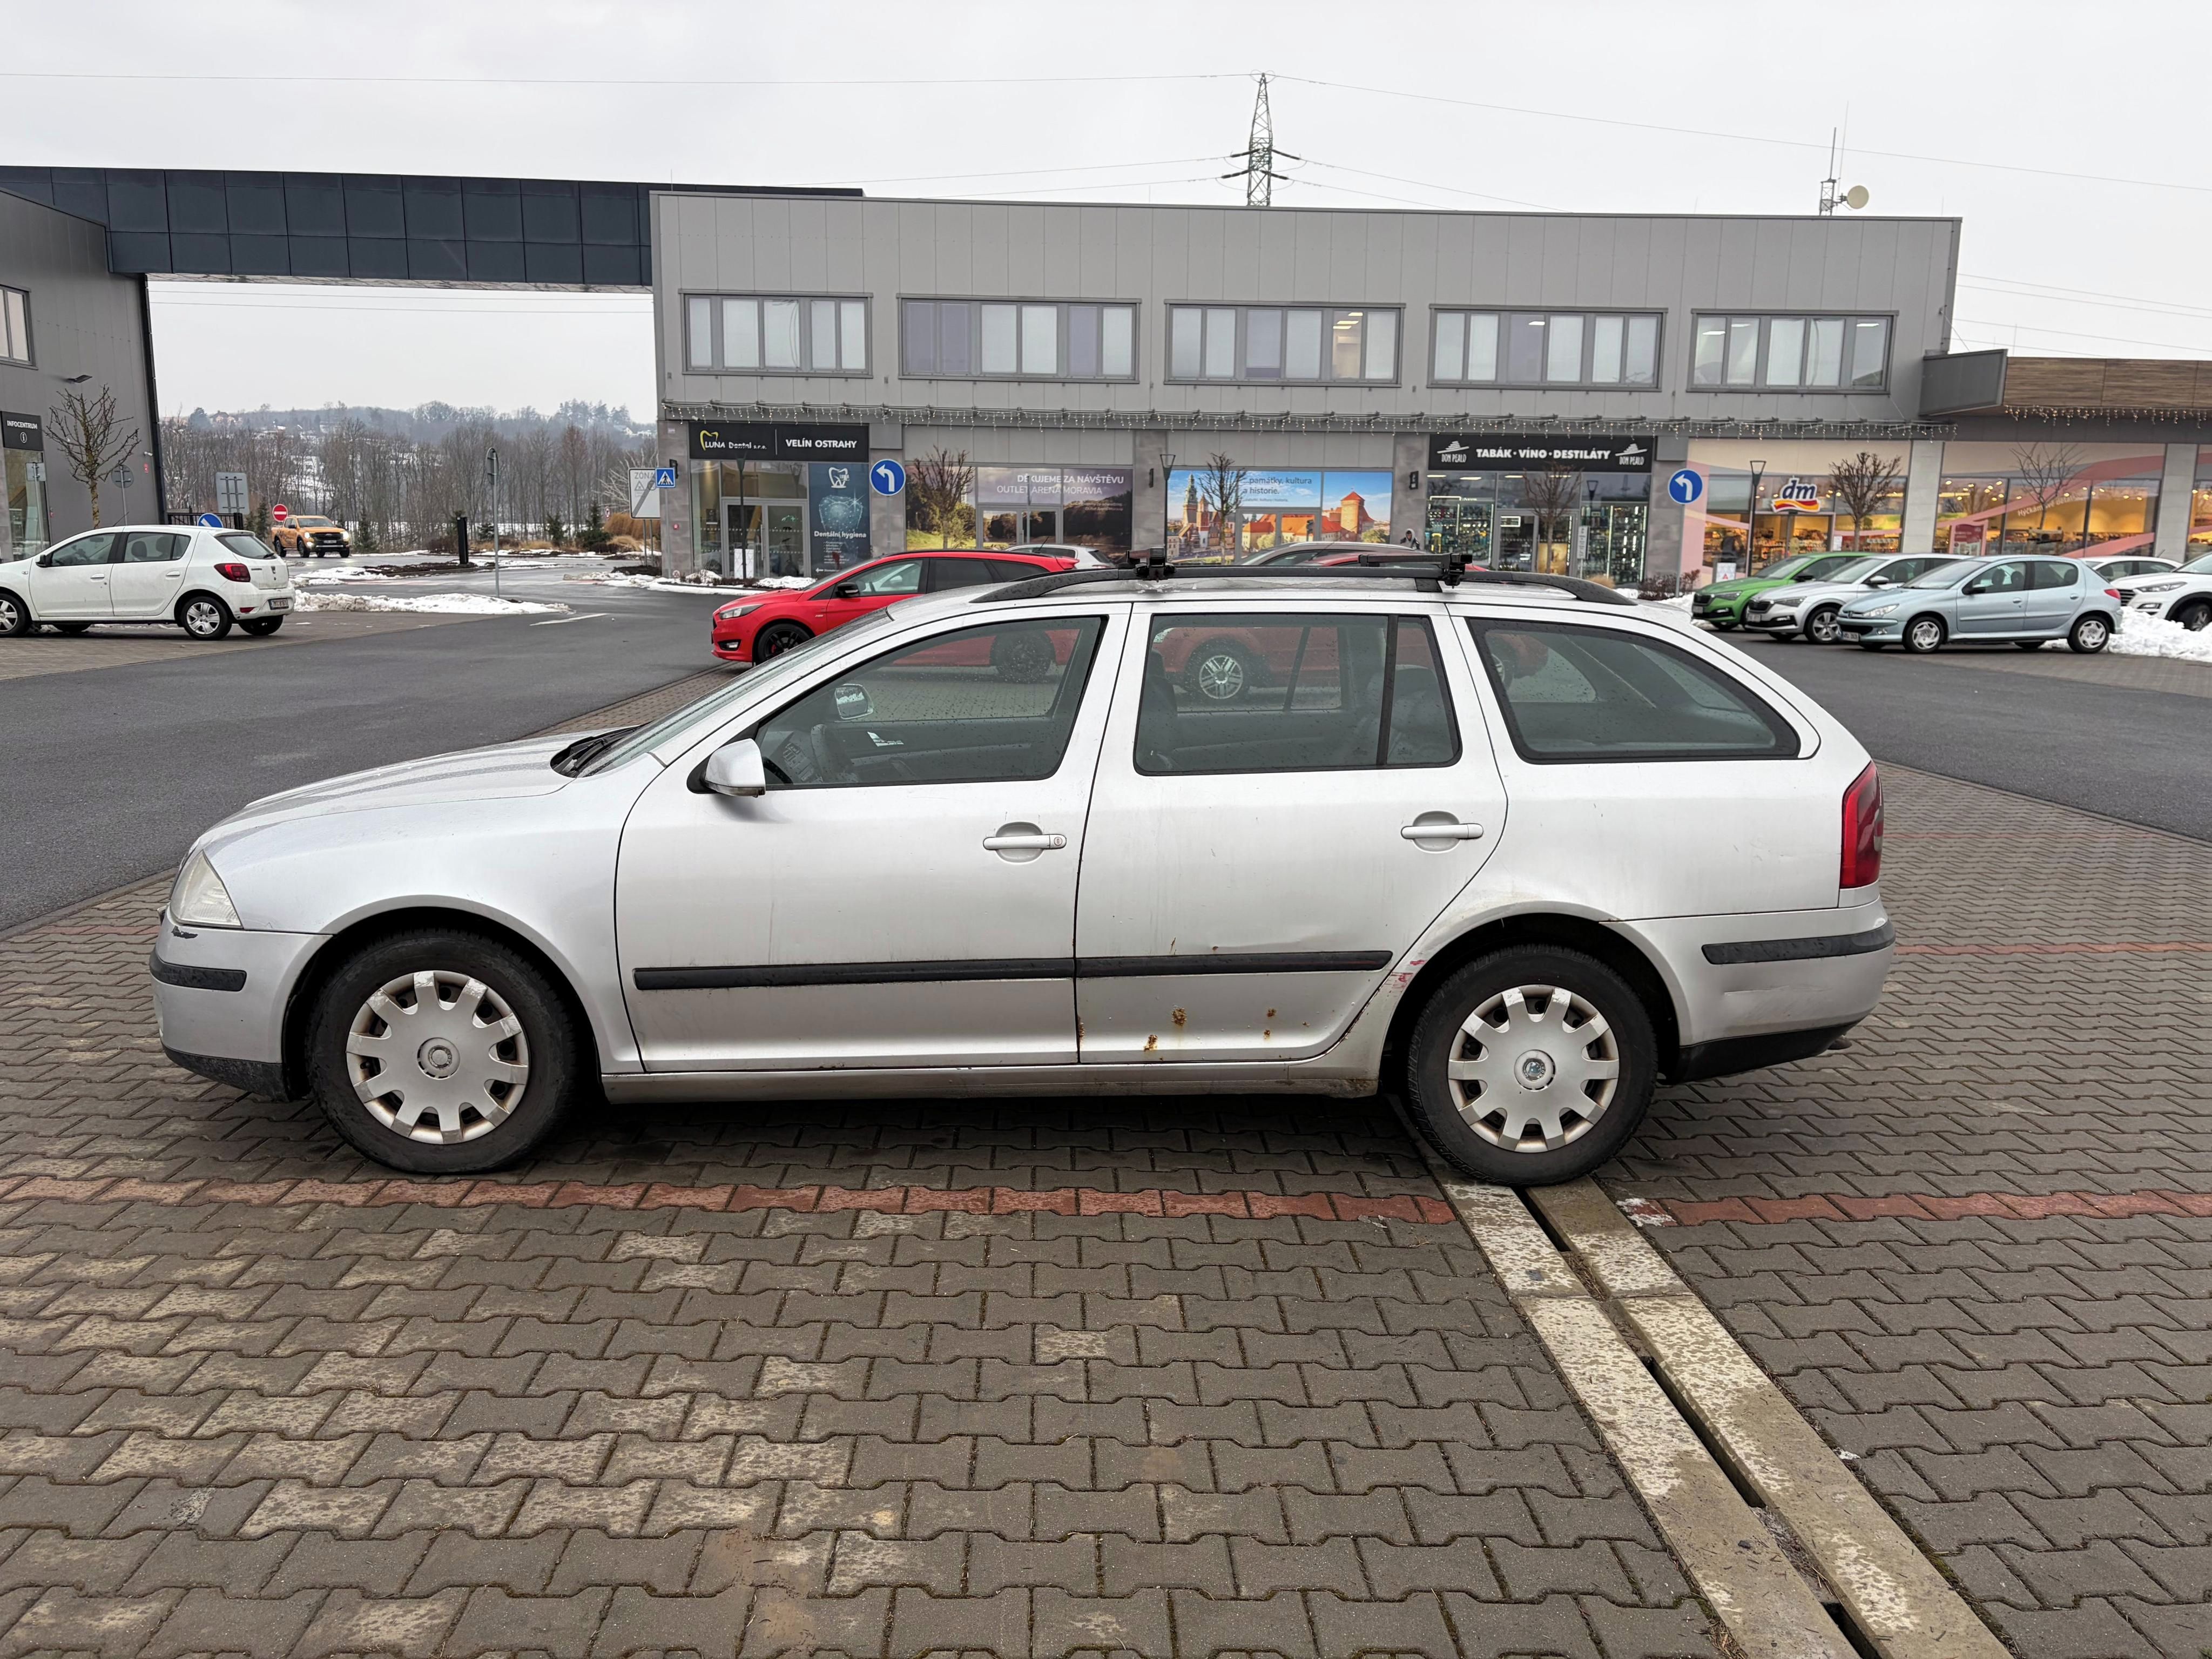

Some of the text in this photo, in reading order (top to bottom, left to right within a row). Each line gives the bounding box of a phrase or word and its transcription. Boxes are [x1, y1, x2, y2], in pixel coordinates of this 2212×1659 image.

[6, 420, 38, 429] INFOCENTRUM
[785, 437, 857, 448] VELÍN OSTRAHY
[1476, 447, 1611, 459] TABÁK VÍNO DESTILÁTY
[1064, 475, 1075, 483] ZA
[1077, 474, 1124, 484] NÁVŠTĚVU
[1782, 480, 1816, 500] dm
